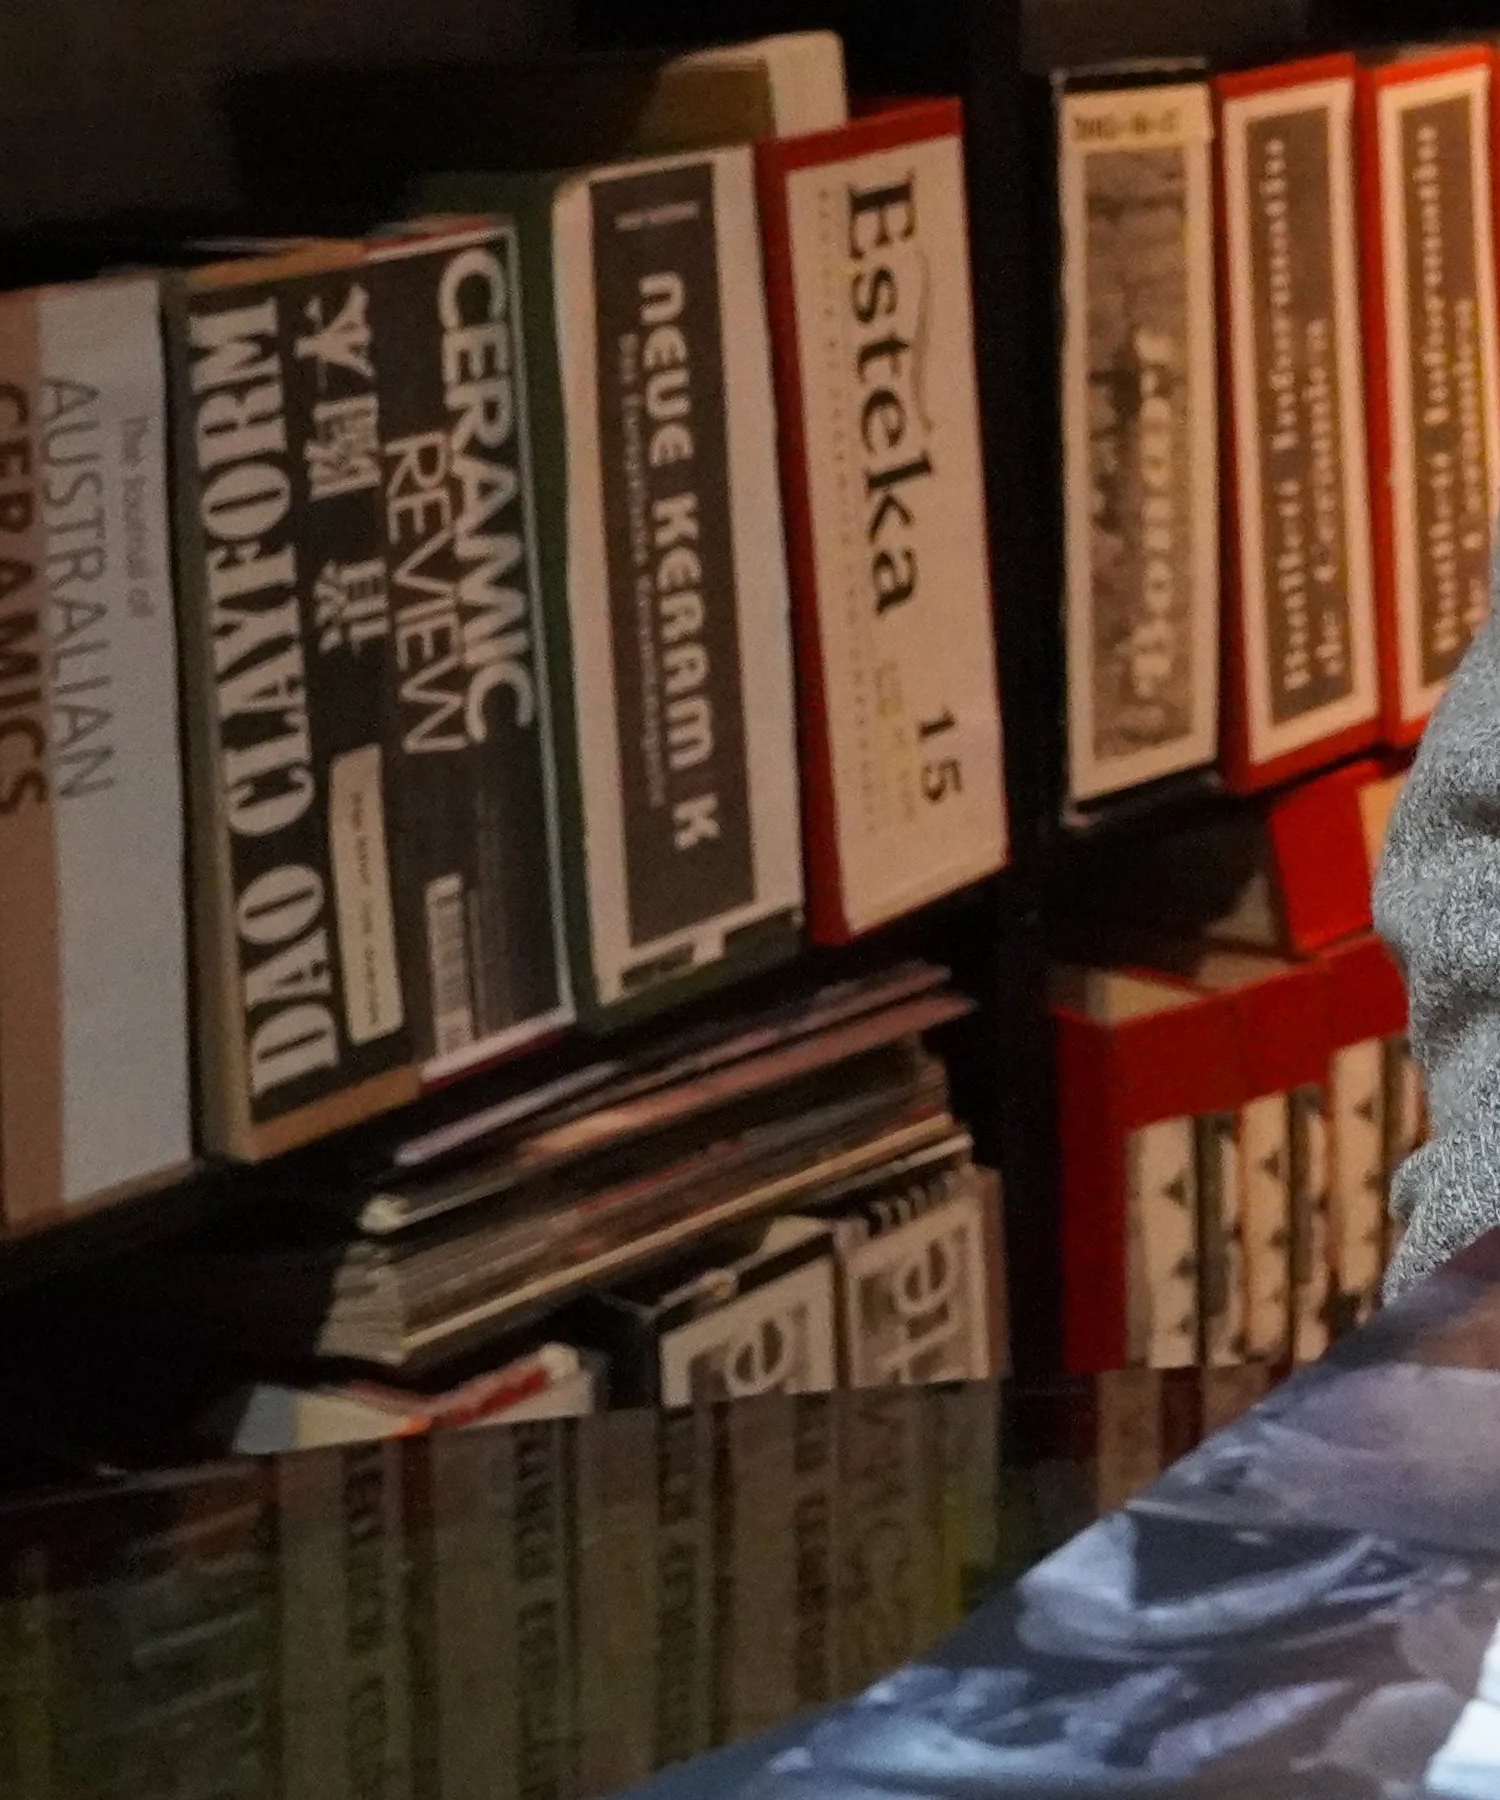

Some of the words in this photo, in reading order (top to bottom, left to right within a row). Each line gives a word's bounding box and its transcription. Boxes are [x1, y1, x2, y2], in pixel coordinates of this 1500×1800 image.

[437, 247, 534, 740] CERAMIC
[636, 271, 696, 460] NEUE
[846, 171, 935, 616] Esteka
[40, 377, 117, 800] AUSTRALIAN
[188, 296, 317, 837] CLAYFORM
[386, 437, 468, 754] REVIEW
[917, 708, 963, 807] 15
[236, 865, 340, 1095] DAO
